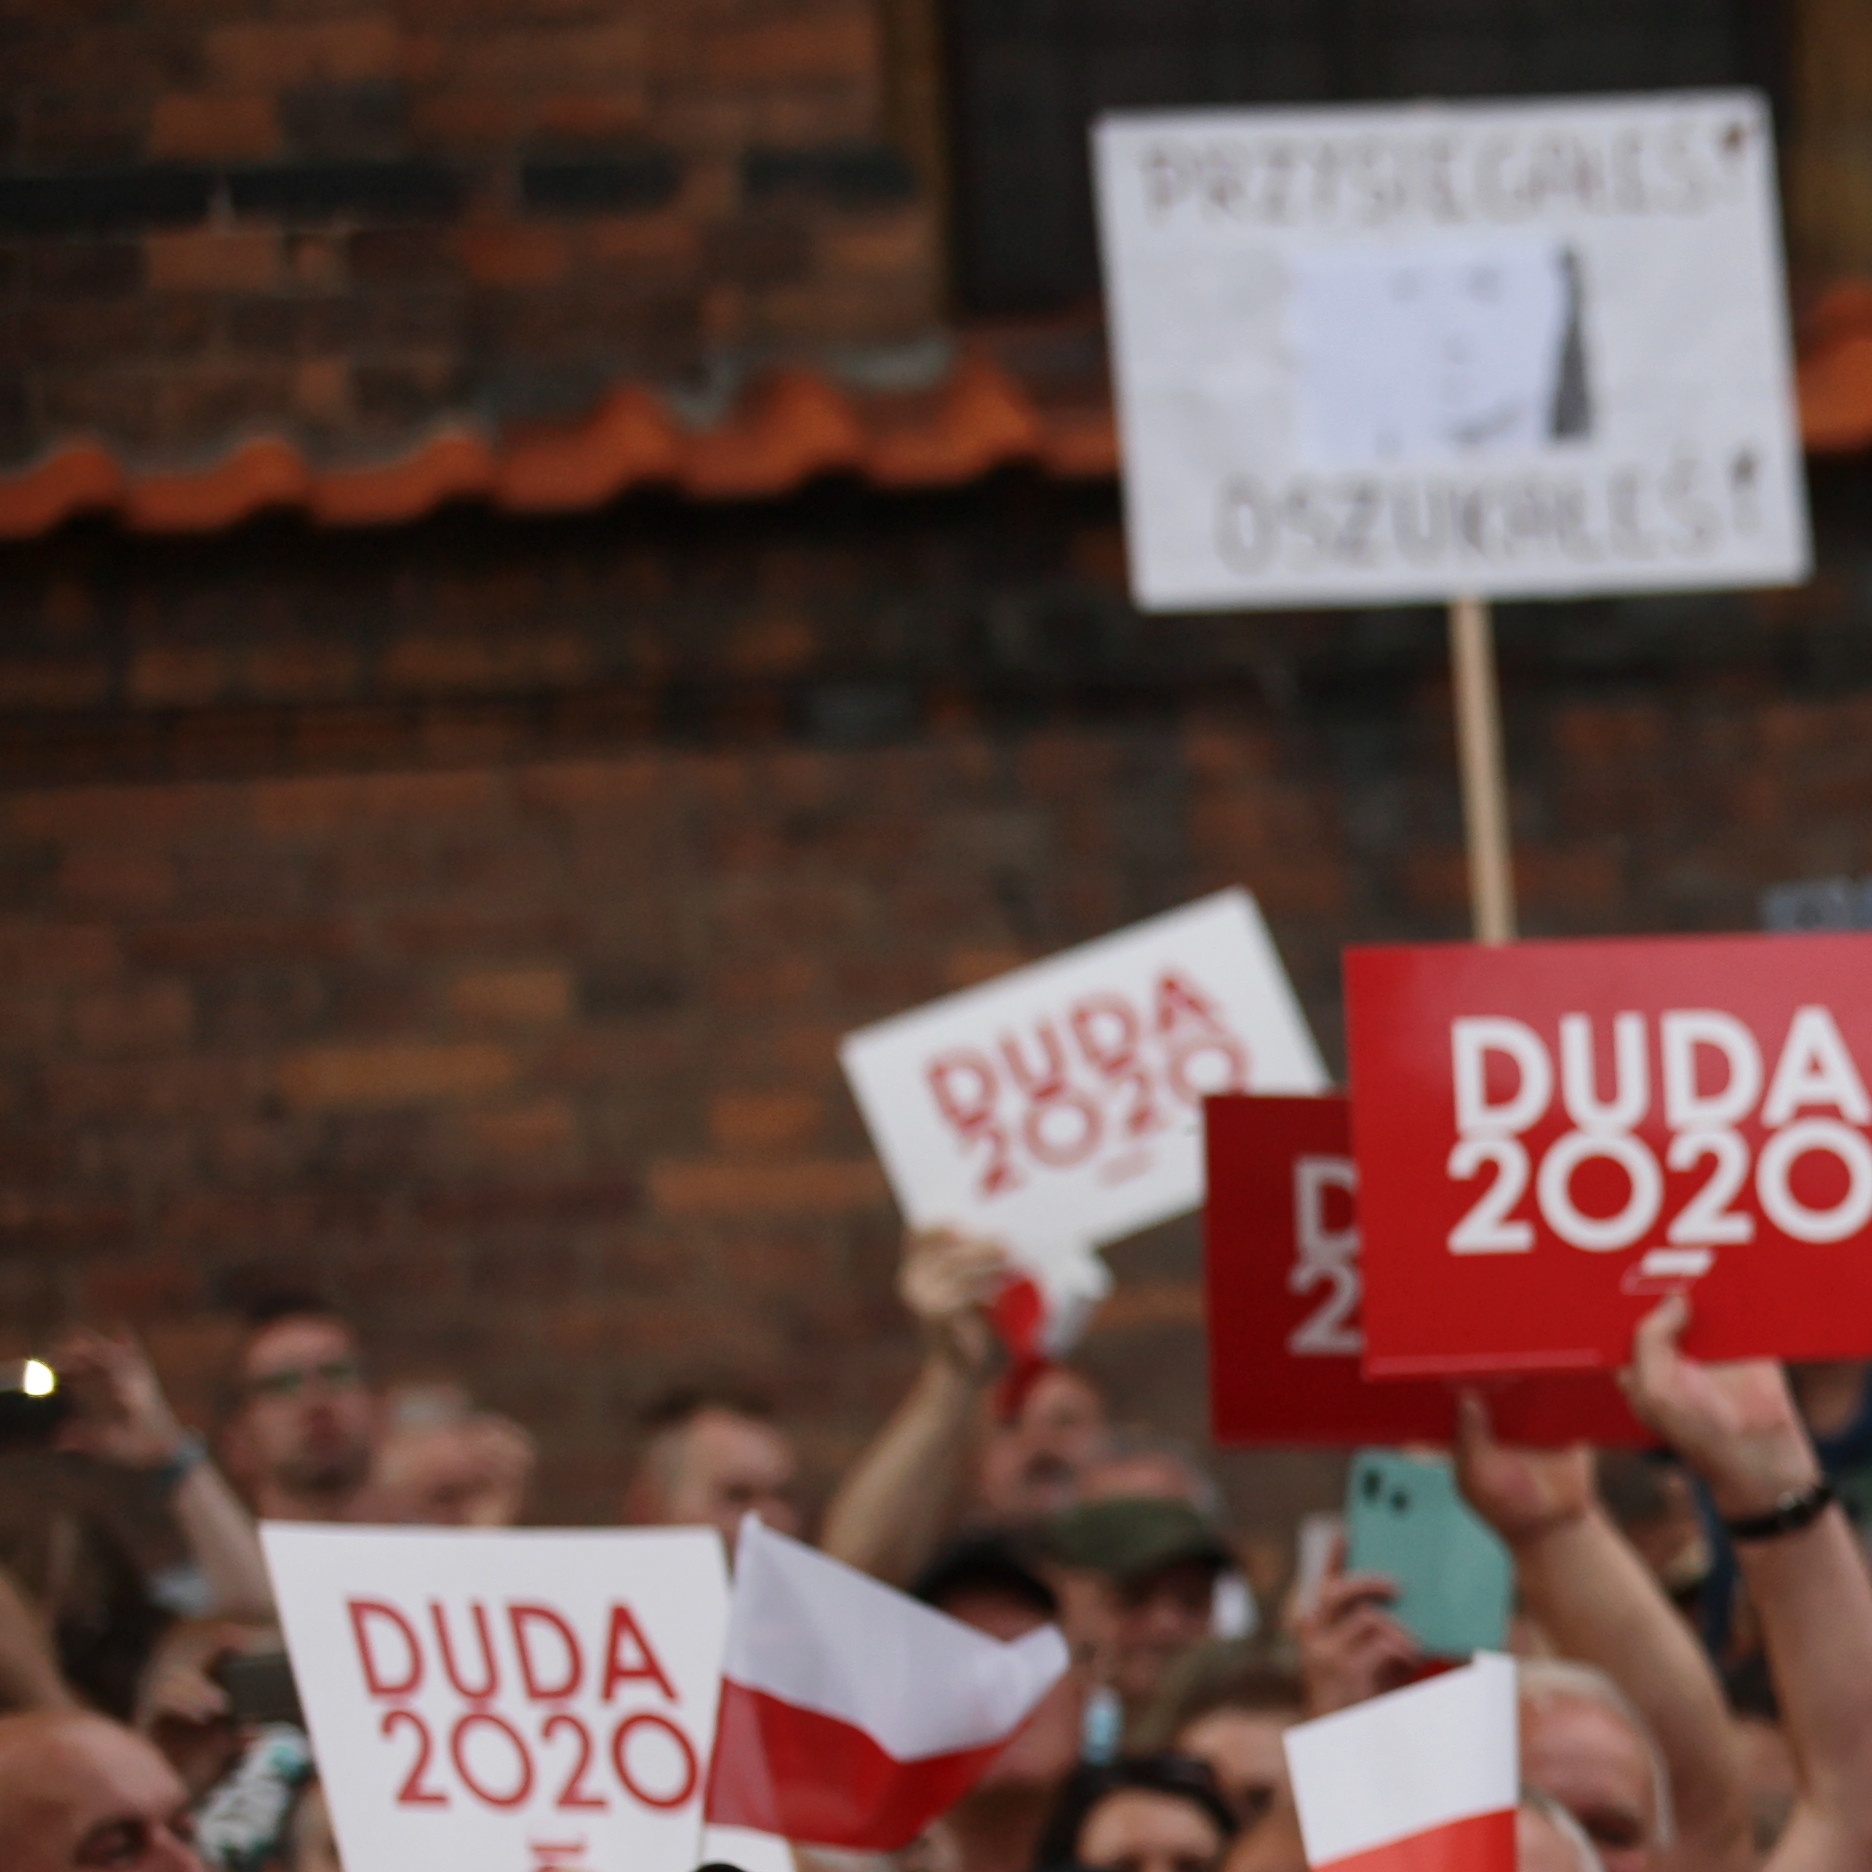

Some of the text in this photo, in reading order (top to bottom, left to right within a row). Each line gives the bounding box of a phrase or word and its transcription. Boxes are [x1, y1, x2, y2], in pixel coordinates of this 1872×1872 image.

[923, 965, 1228, 1134] DUDA
[962, 1032, 1253, 1200] 2020
[346, 1595, 678, 1705] DUDA
[380, 1707, 701, 1810] 2020
